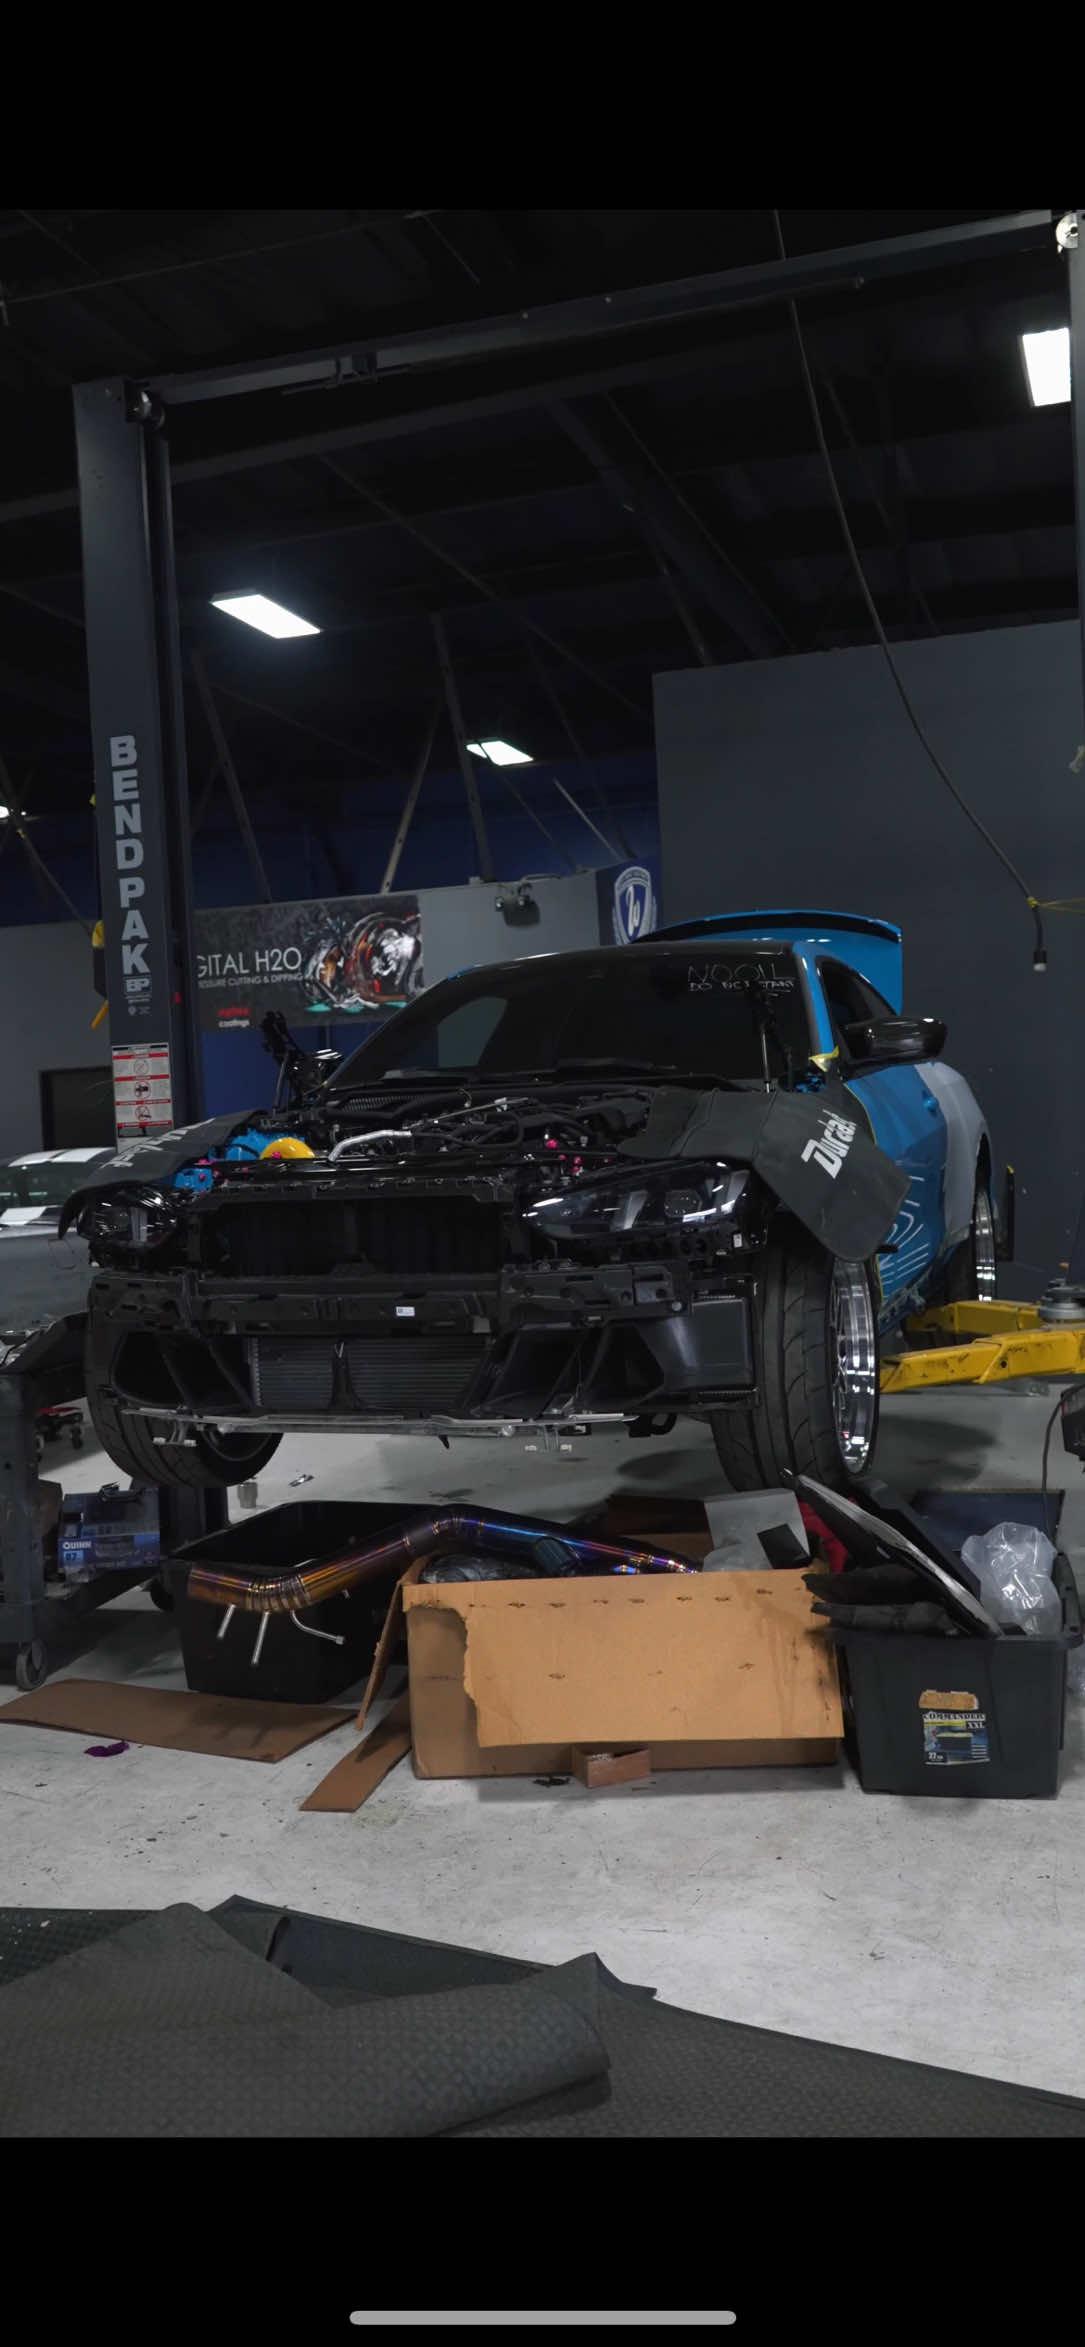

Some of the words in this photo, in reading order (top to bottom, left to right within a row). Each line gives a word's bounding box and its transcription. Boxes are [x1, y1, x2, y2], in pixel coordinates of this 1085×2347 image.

[110, 735, 151, 975] BENDPAK
[255, 947, 302, 972] H2O
[126, 978, 150, 993] BP
[922, 1711, 986, 1721] COMMANDER
